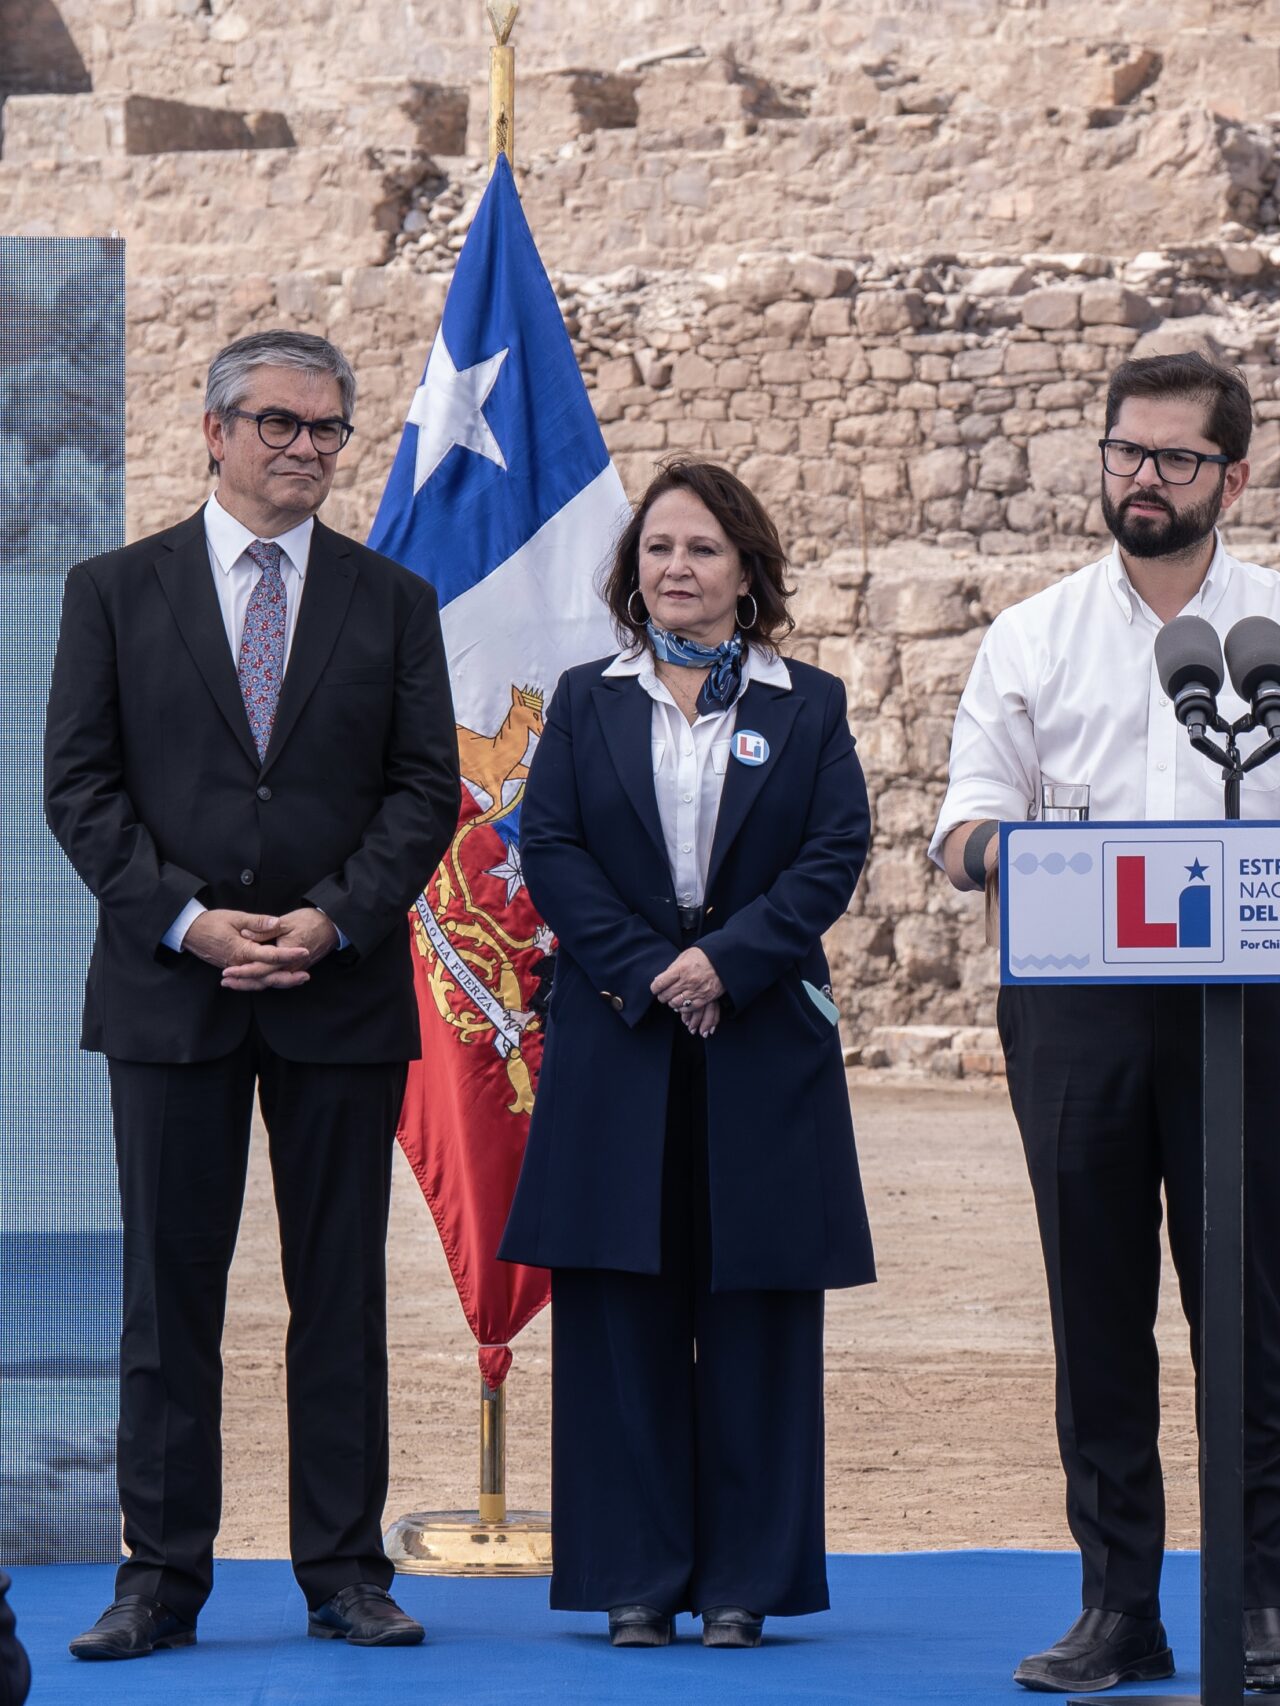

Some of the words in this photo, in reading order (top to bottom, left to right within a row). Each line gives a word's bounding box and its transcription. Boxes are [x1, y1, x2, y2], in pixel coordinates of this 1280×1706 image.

[1116, 855, 1211, 948] Li
[1239, 904, 1279, 922] DEL
[1240, 939, 1260, 950] Por
[437, 941, 452, 960] LA
[451, 962, 492, 1012] FUERZA
